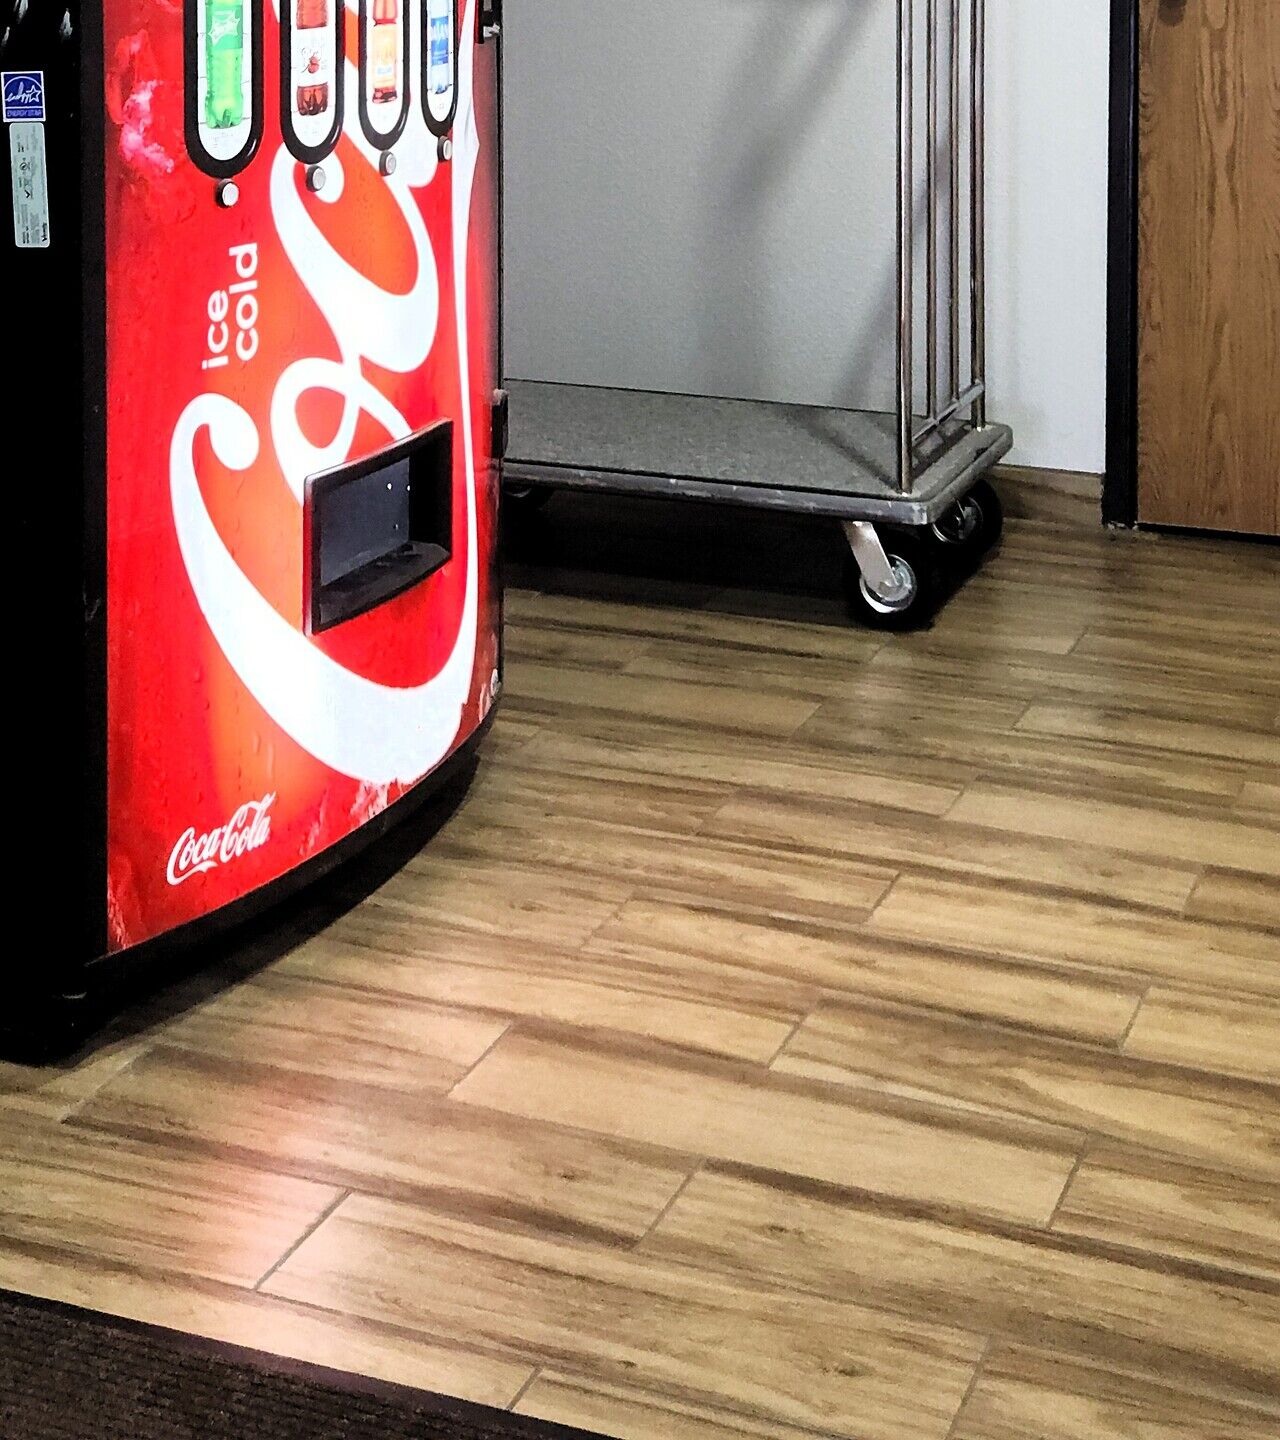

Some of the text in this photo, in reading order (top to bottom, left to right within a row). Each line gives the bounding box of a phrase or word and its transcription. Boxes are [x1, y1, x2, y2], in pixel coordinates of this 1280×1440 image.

[201, 289, 229, 370] ice
[228, 242, 259, 361] cold
[166, 790, 277, 886] Coca-Cola
